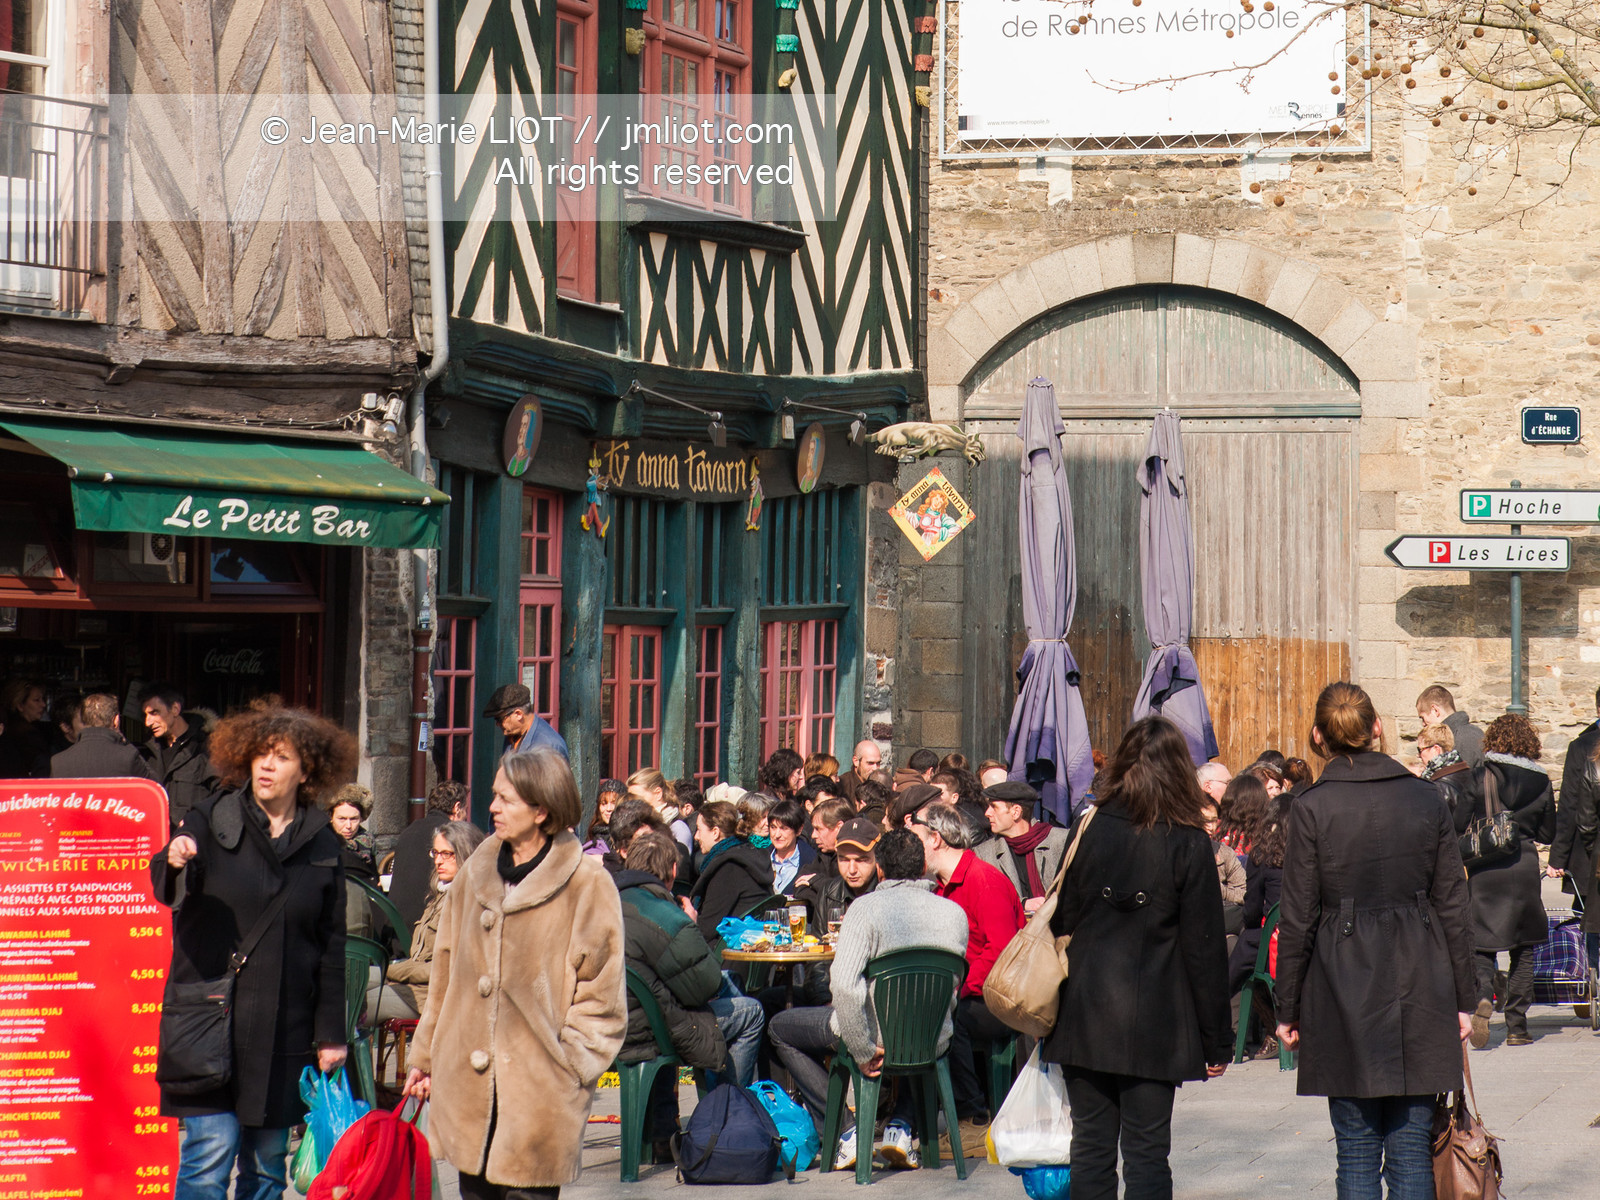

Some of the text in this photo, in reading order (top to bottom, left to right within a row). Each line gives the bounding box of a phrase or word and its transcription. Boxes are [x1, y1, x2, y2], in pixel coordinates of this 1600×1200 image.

[1002, 6, 1300, 38] de Rennes Métropole
[1544, 412, 1558, 422] Rue
[604, 440, 747, 494] ty anna tavarn
[1498, 498, 1562, 515] Hoche
[163, 495, 371, 539] Le Petit Bar
[1458, 545, 1490, 561] Les
[1506, 545, 1559, 561] Lices
[63, 793, 83, 809] de
[85, 794, 101, 811] la
[103, 798, 146, 822] Place
[4, 882, 132, 893] ASSIETTES ET SANDWICHS
[49, 895, 73, 904] AVEC
[75, 895, 94, 904] DES
[96, 894, 146, 904] PRODUITS
[36, 906, 60, 916] AUX
[62, 906, 106, 916] SAVEURS
[108, 905, 124, 914] DU
[126, 905, 160, 914] LIBAN.
[40, 928, 70, 938] LAHMÉ
[130, 927, 154, 938] 8,50
[155, 927, 163, 936] €
[48, 972, 78, 981] LAHMÉ
[131, 969, 154, 980] 4,50
[156, 969, 164, 978] €
[42, 1008, 63, 1016] DJAJ
[132, 1004, 156, 1014] 8,50
[49, 1050, 70, 1060] DJAJ
[133, 1046, 157, 1056] 4,50
[25, 1068, 55, 1077] TAOUK
[133, 1064, 158, 1074] 8,50
[30, 1110, 60, 1120] TAOUK
[134, 1106, 158, 1117] 4,50
[134, 1124, 159, 1135] 8,50
[160, 1123, 168, 1133] €
[136, 1166, 160, 1178] 4,50
[161, 1166, 169, 1176] €
[136, 1184, 161, 1195] 7,50
[162, 1184, 170, 1193] €
